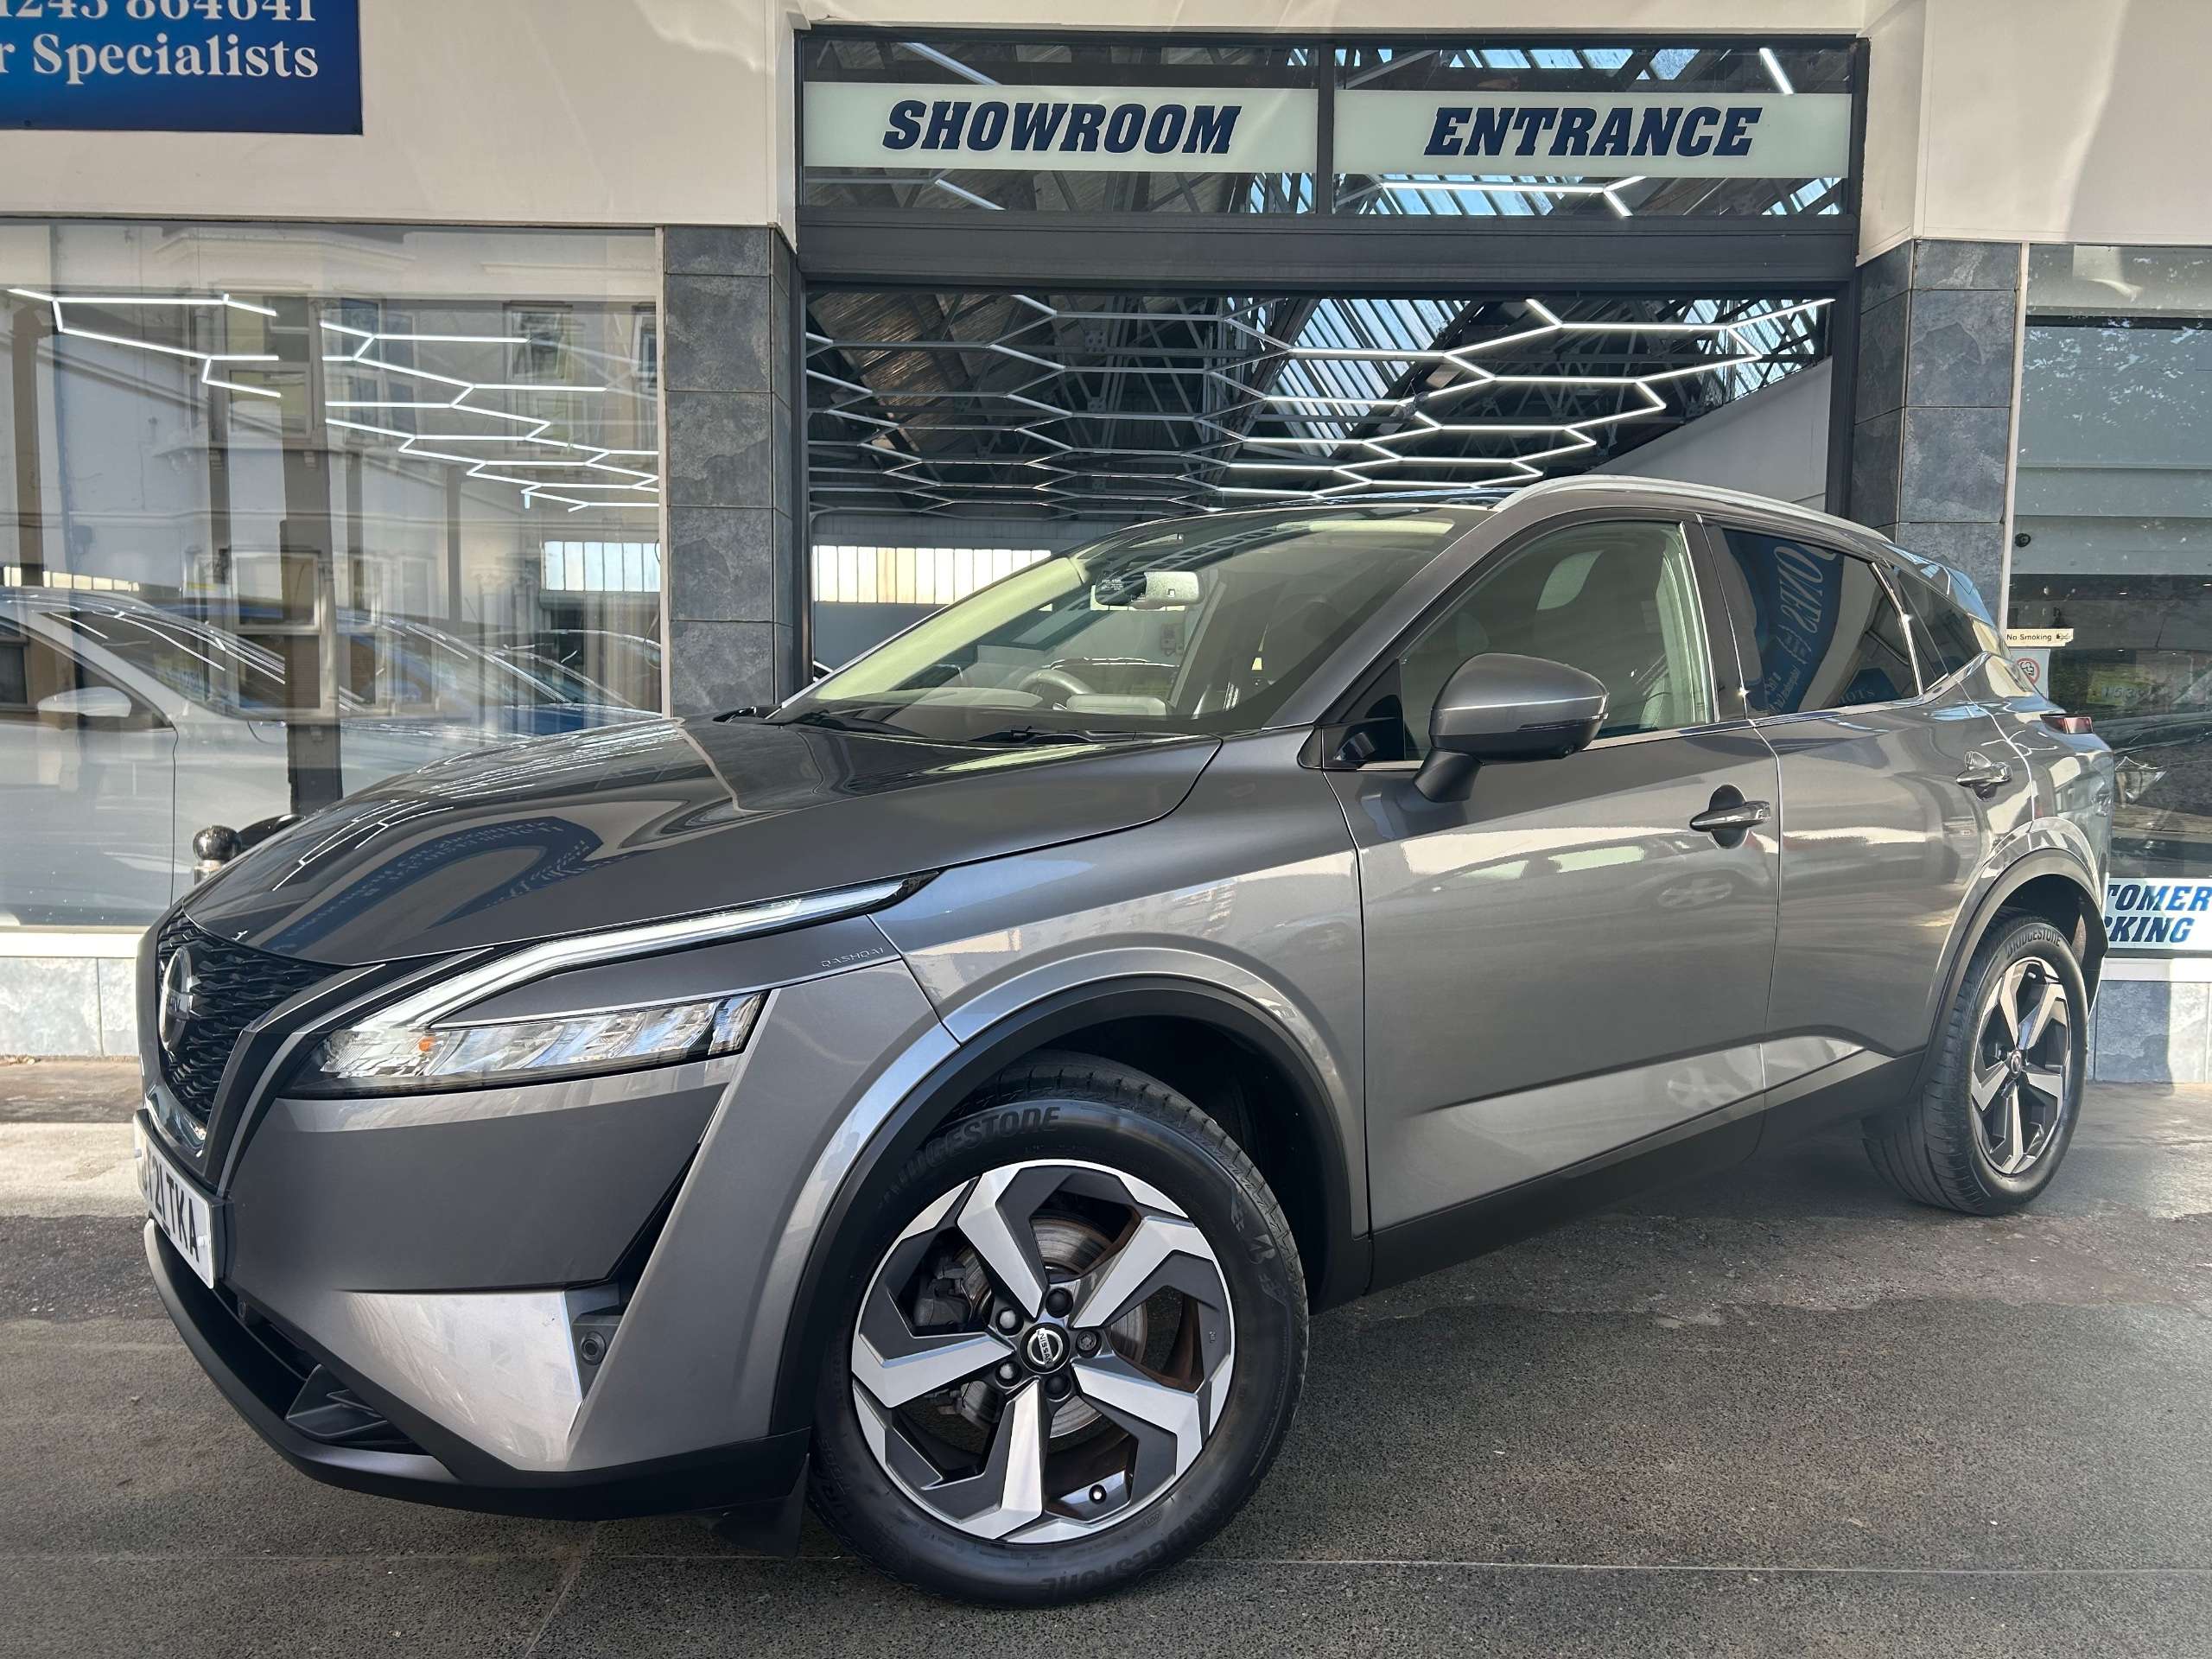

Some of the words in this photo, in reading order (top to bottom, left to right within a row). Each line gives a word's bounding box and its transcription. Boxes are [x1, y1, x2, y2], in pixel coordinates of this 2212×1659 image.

[33, 34, 319, 85] Specialists
[882, 99, 1242, 154] SHOWROOM
[1423, 106, 1763, 157] ENTRANCE
[821, 947, 884, 968] QASHQAI
[166, 1171, 200, 1262] TKA
[1039, 1332, 1052, 1364] NISSAN
